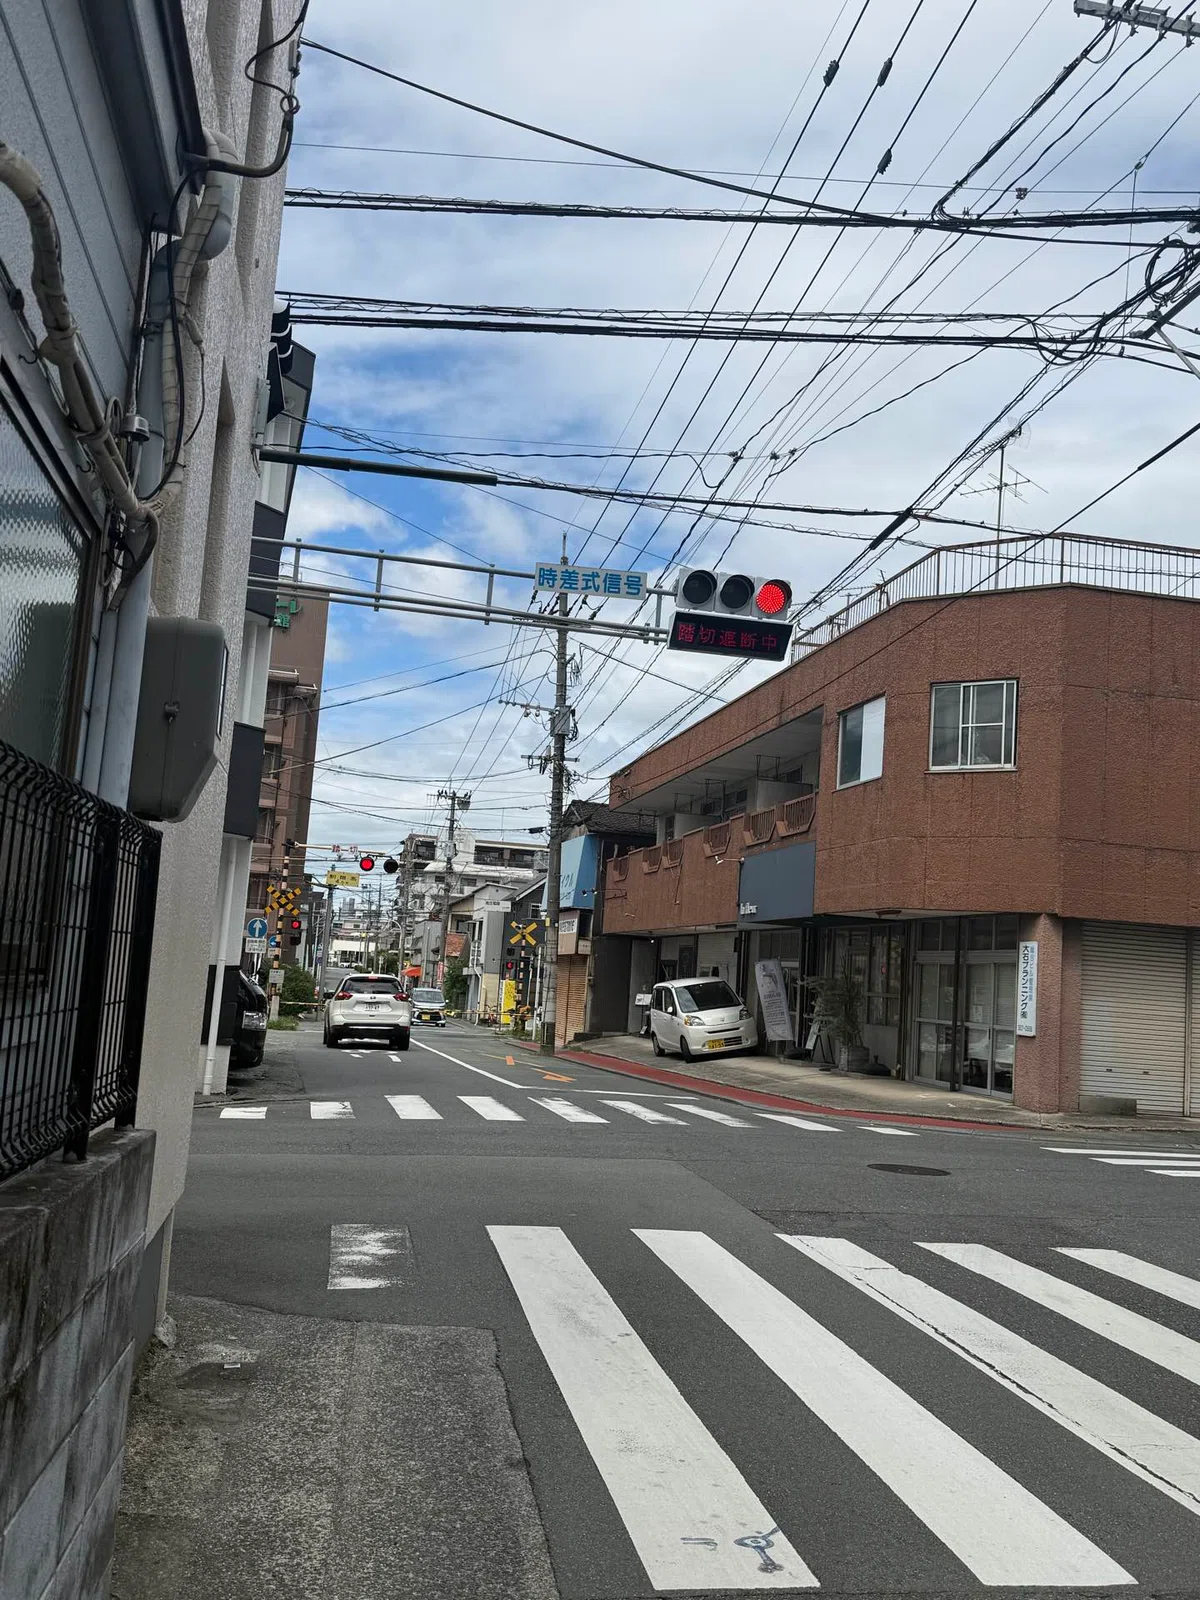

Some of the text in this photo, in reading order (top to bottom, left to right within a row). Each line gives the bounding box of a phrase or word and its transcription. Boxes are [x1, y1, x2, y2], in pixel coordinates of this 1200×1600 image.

[538, 567, 643, 596] 時差式信号
[677, 622, 779, 651] 踏切遮断中
